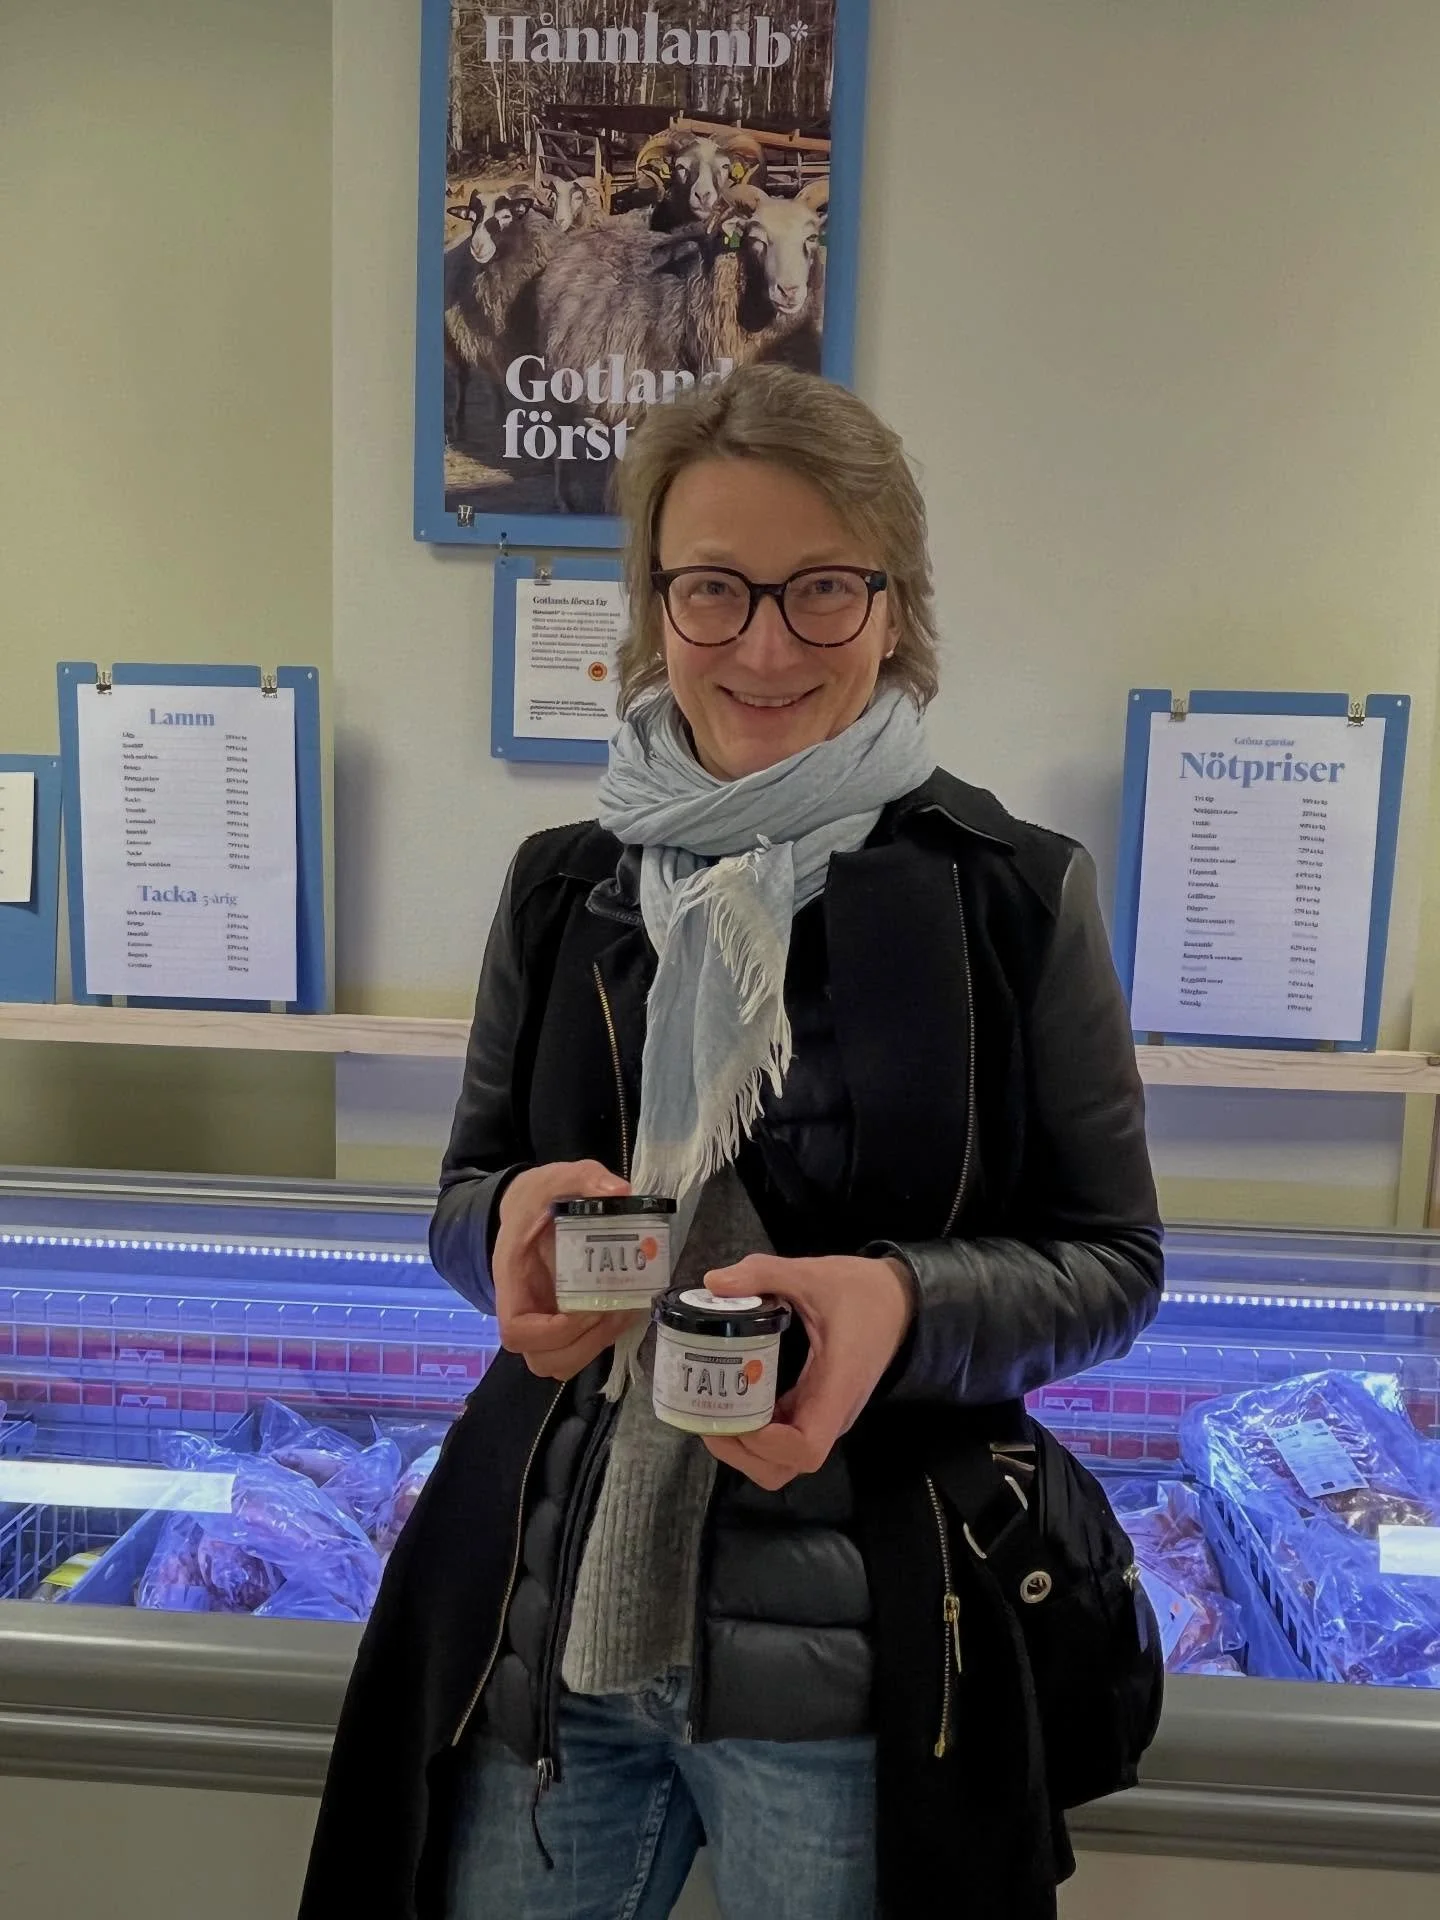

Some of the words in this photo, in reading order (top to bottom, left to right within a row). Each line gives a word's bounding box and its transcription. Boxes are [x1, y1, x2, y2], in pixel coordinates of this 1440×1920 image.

[505, 353, 734, 404] Gotland
[502, 408, 636, 461] först
[149, 708, 215, 726] Lamm
[1179, 752, 1346, 788] Nötpriser
[137, 885, 197, 903] Tacka
